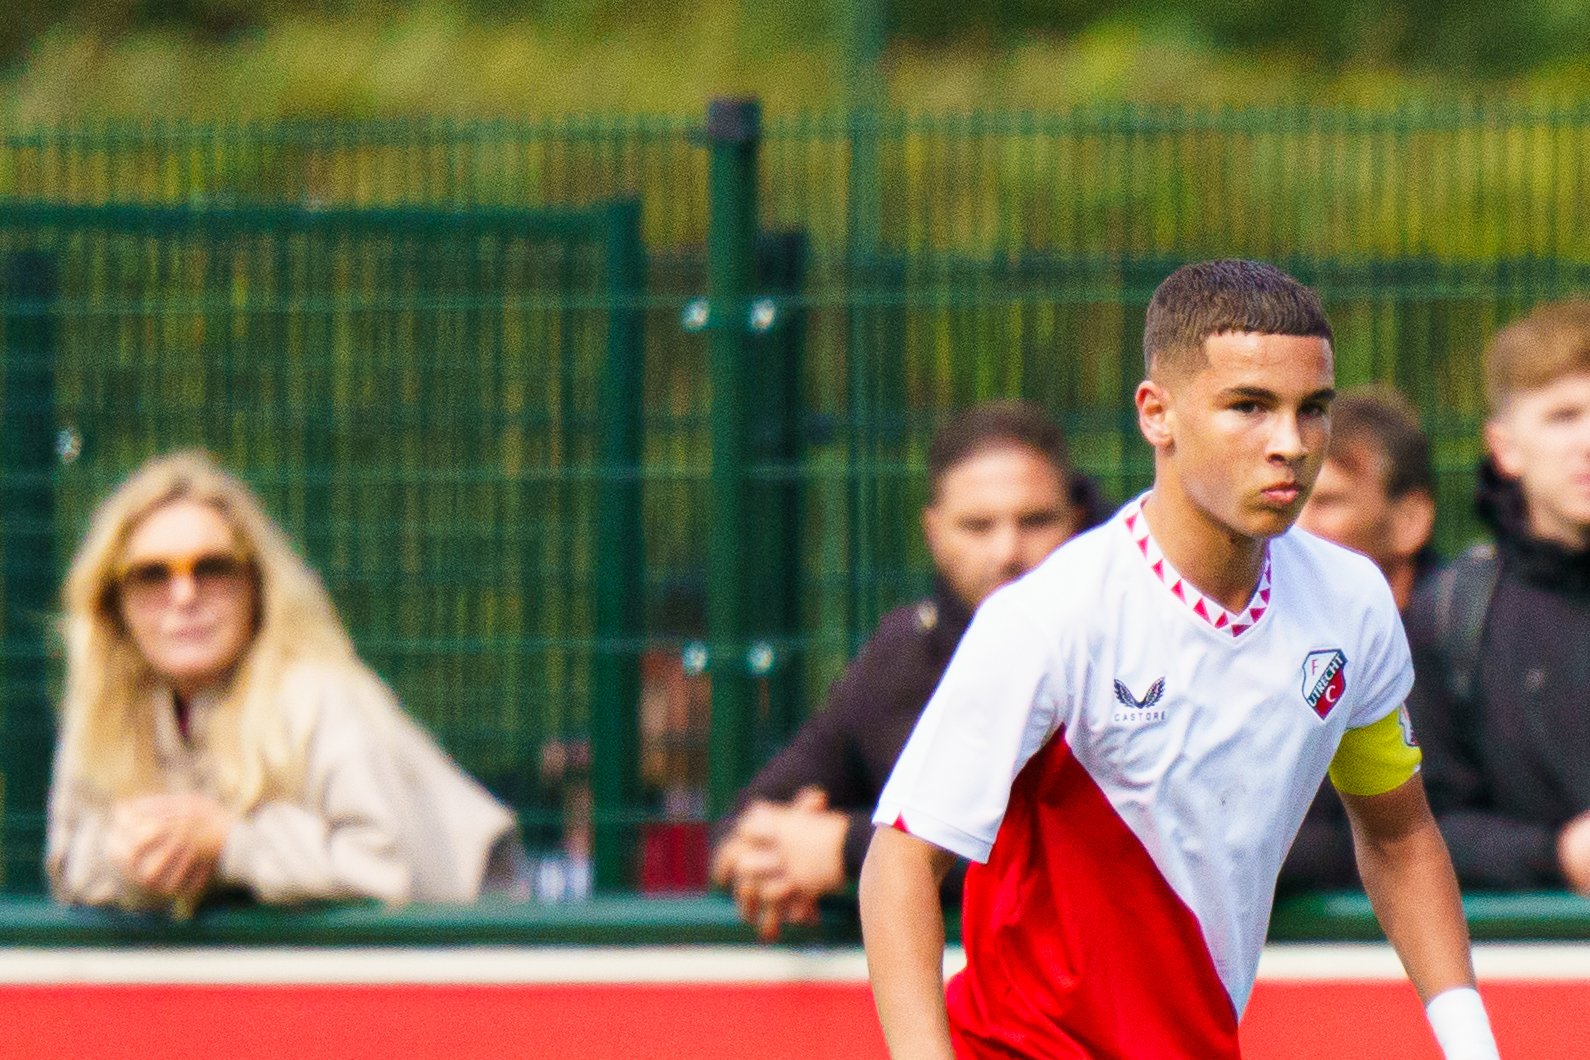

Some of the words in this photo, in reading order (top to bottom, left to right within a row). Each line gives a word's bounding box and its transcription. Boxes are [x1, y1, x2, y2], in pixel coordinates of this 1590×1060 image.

[1308, 656, 1344, 707] UTRECHT
[1325, 685, 1336, 703] C
[1114, 711, 1166, 722] CASTORE
